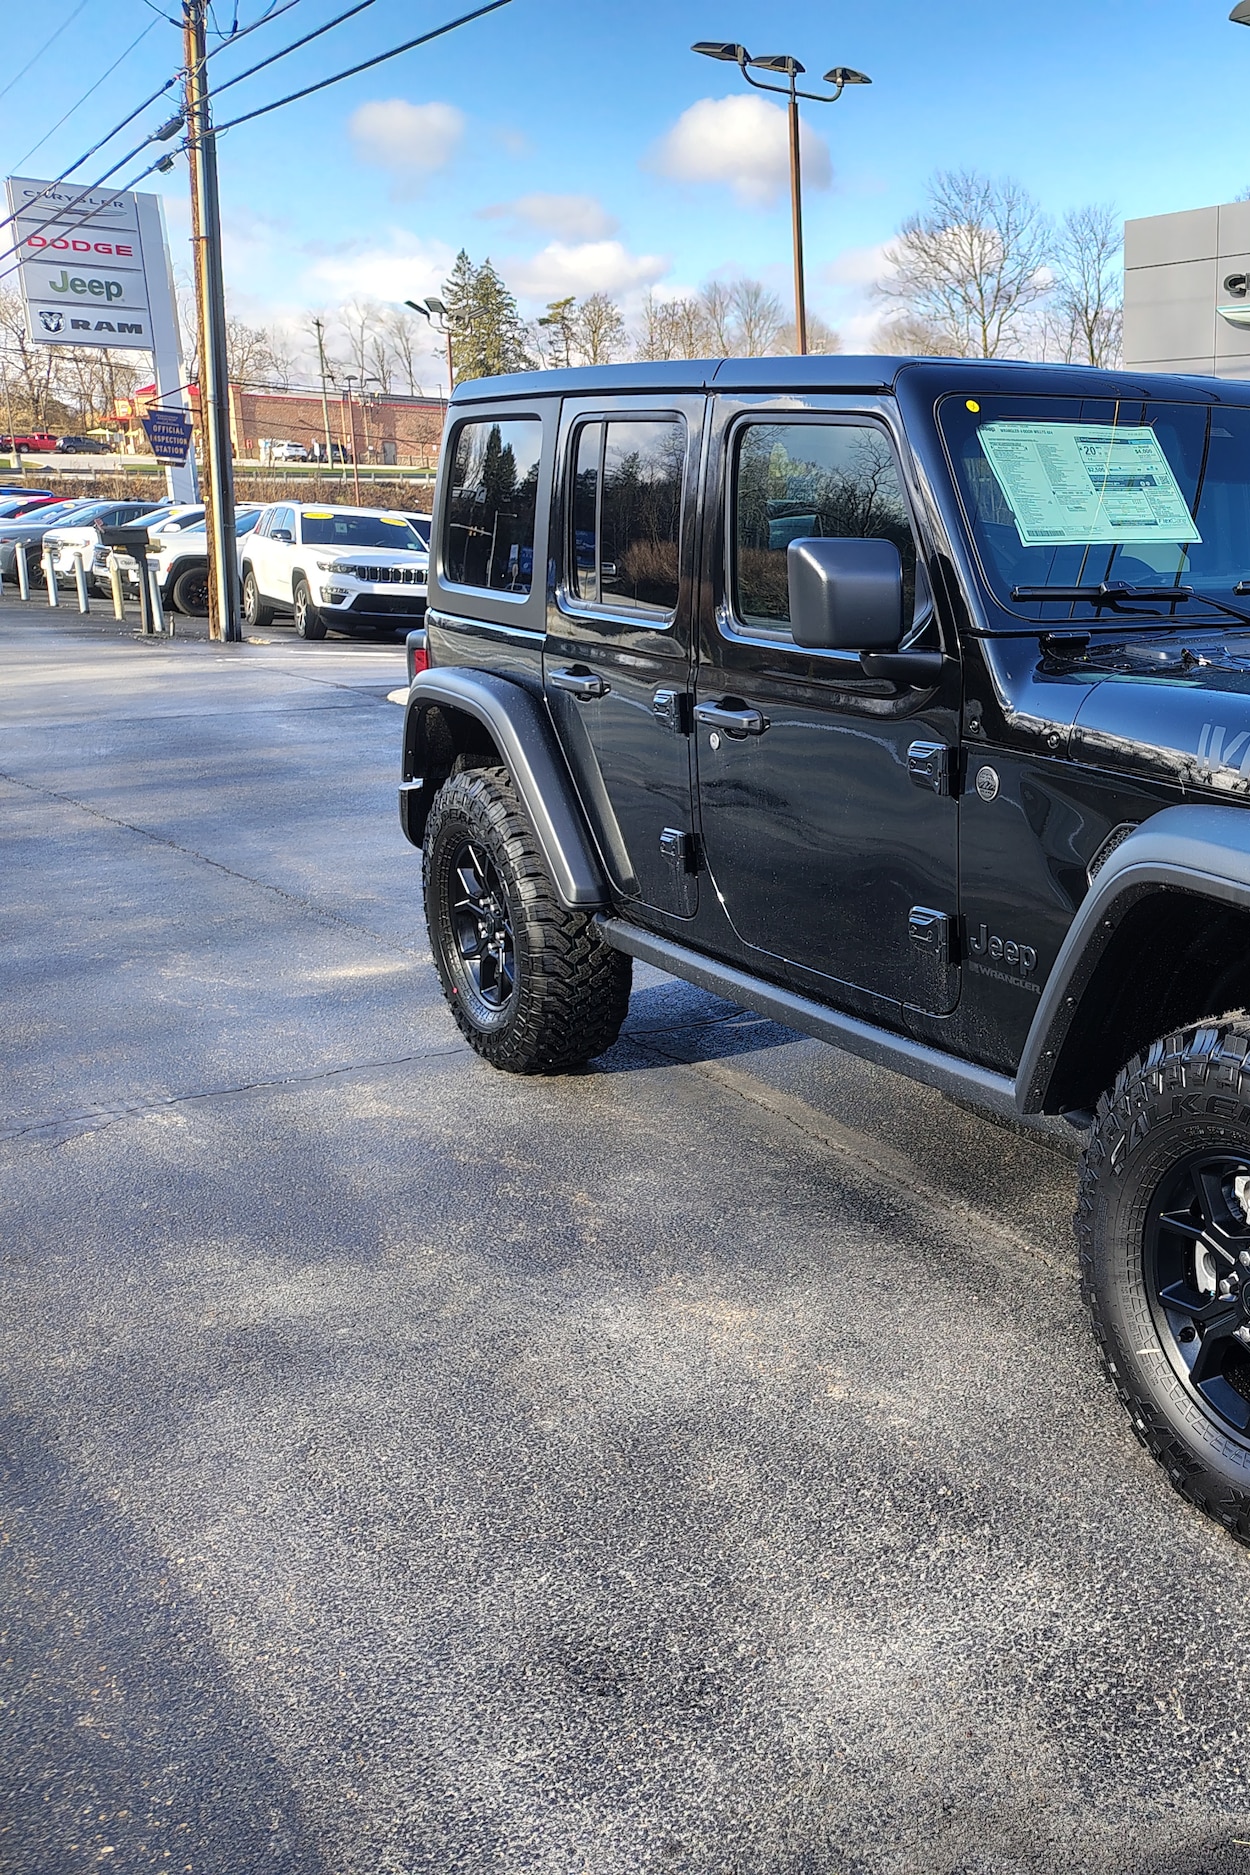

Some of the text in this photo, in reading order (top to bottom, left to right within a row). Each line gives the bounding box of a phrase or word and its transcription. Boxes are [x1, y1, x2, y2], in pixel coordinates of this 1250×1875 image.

[23, 189, 125, 209] CHRYSLER
[27, 236, 133, 257] DODGE
[49, 270, 123, 301] Jeep
[71, 318, 143, 334] RAM
[152, 424, 184, 435] OFFICIAL
[150, 435, 187, 445] INSPECTION
[155, 445, 184, 454] STATION
[970, 923, 1036, 976] Jeep
[979, 964, 1041, 995] WRANGLER
